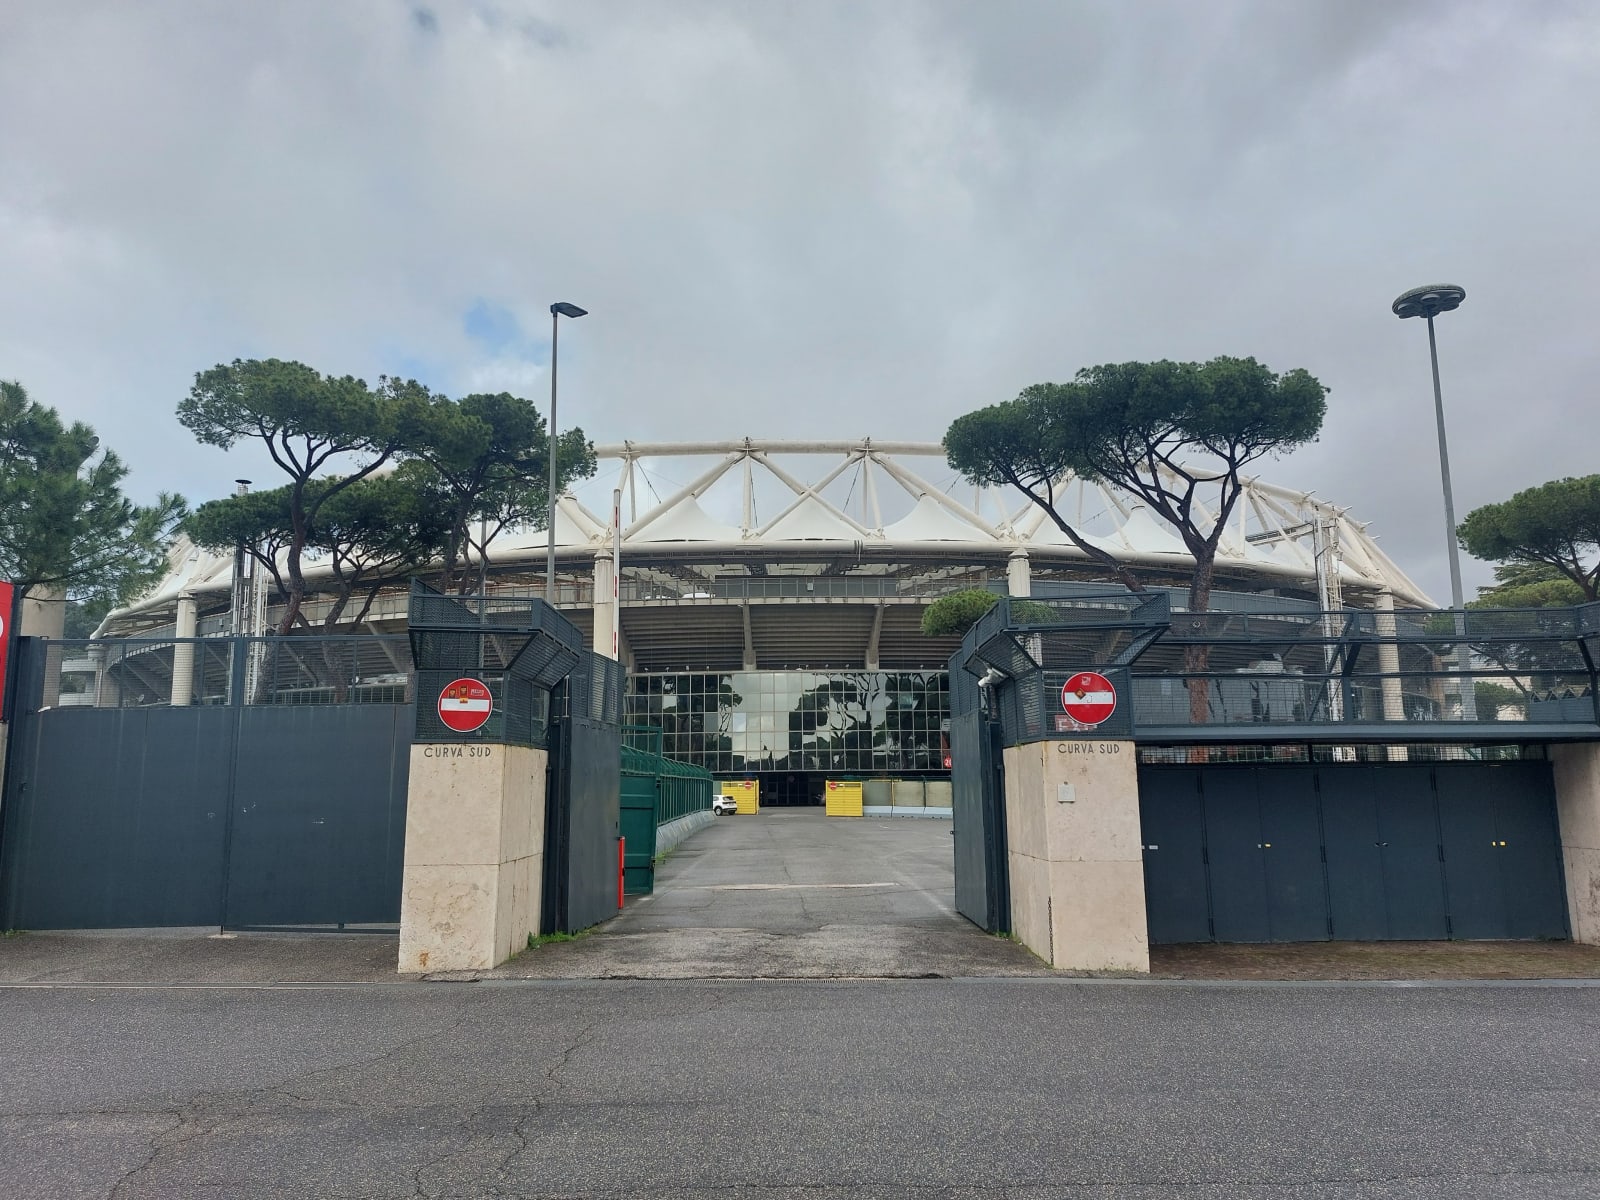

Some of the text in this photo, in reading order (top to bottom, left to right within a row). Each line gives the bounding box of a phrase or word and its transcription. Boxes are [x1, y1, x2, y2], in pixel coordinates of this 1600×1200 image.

[424, 746, 491, 758] CURVA SUD
[1057, 743, 1120, 754] CURVA SUD
